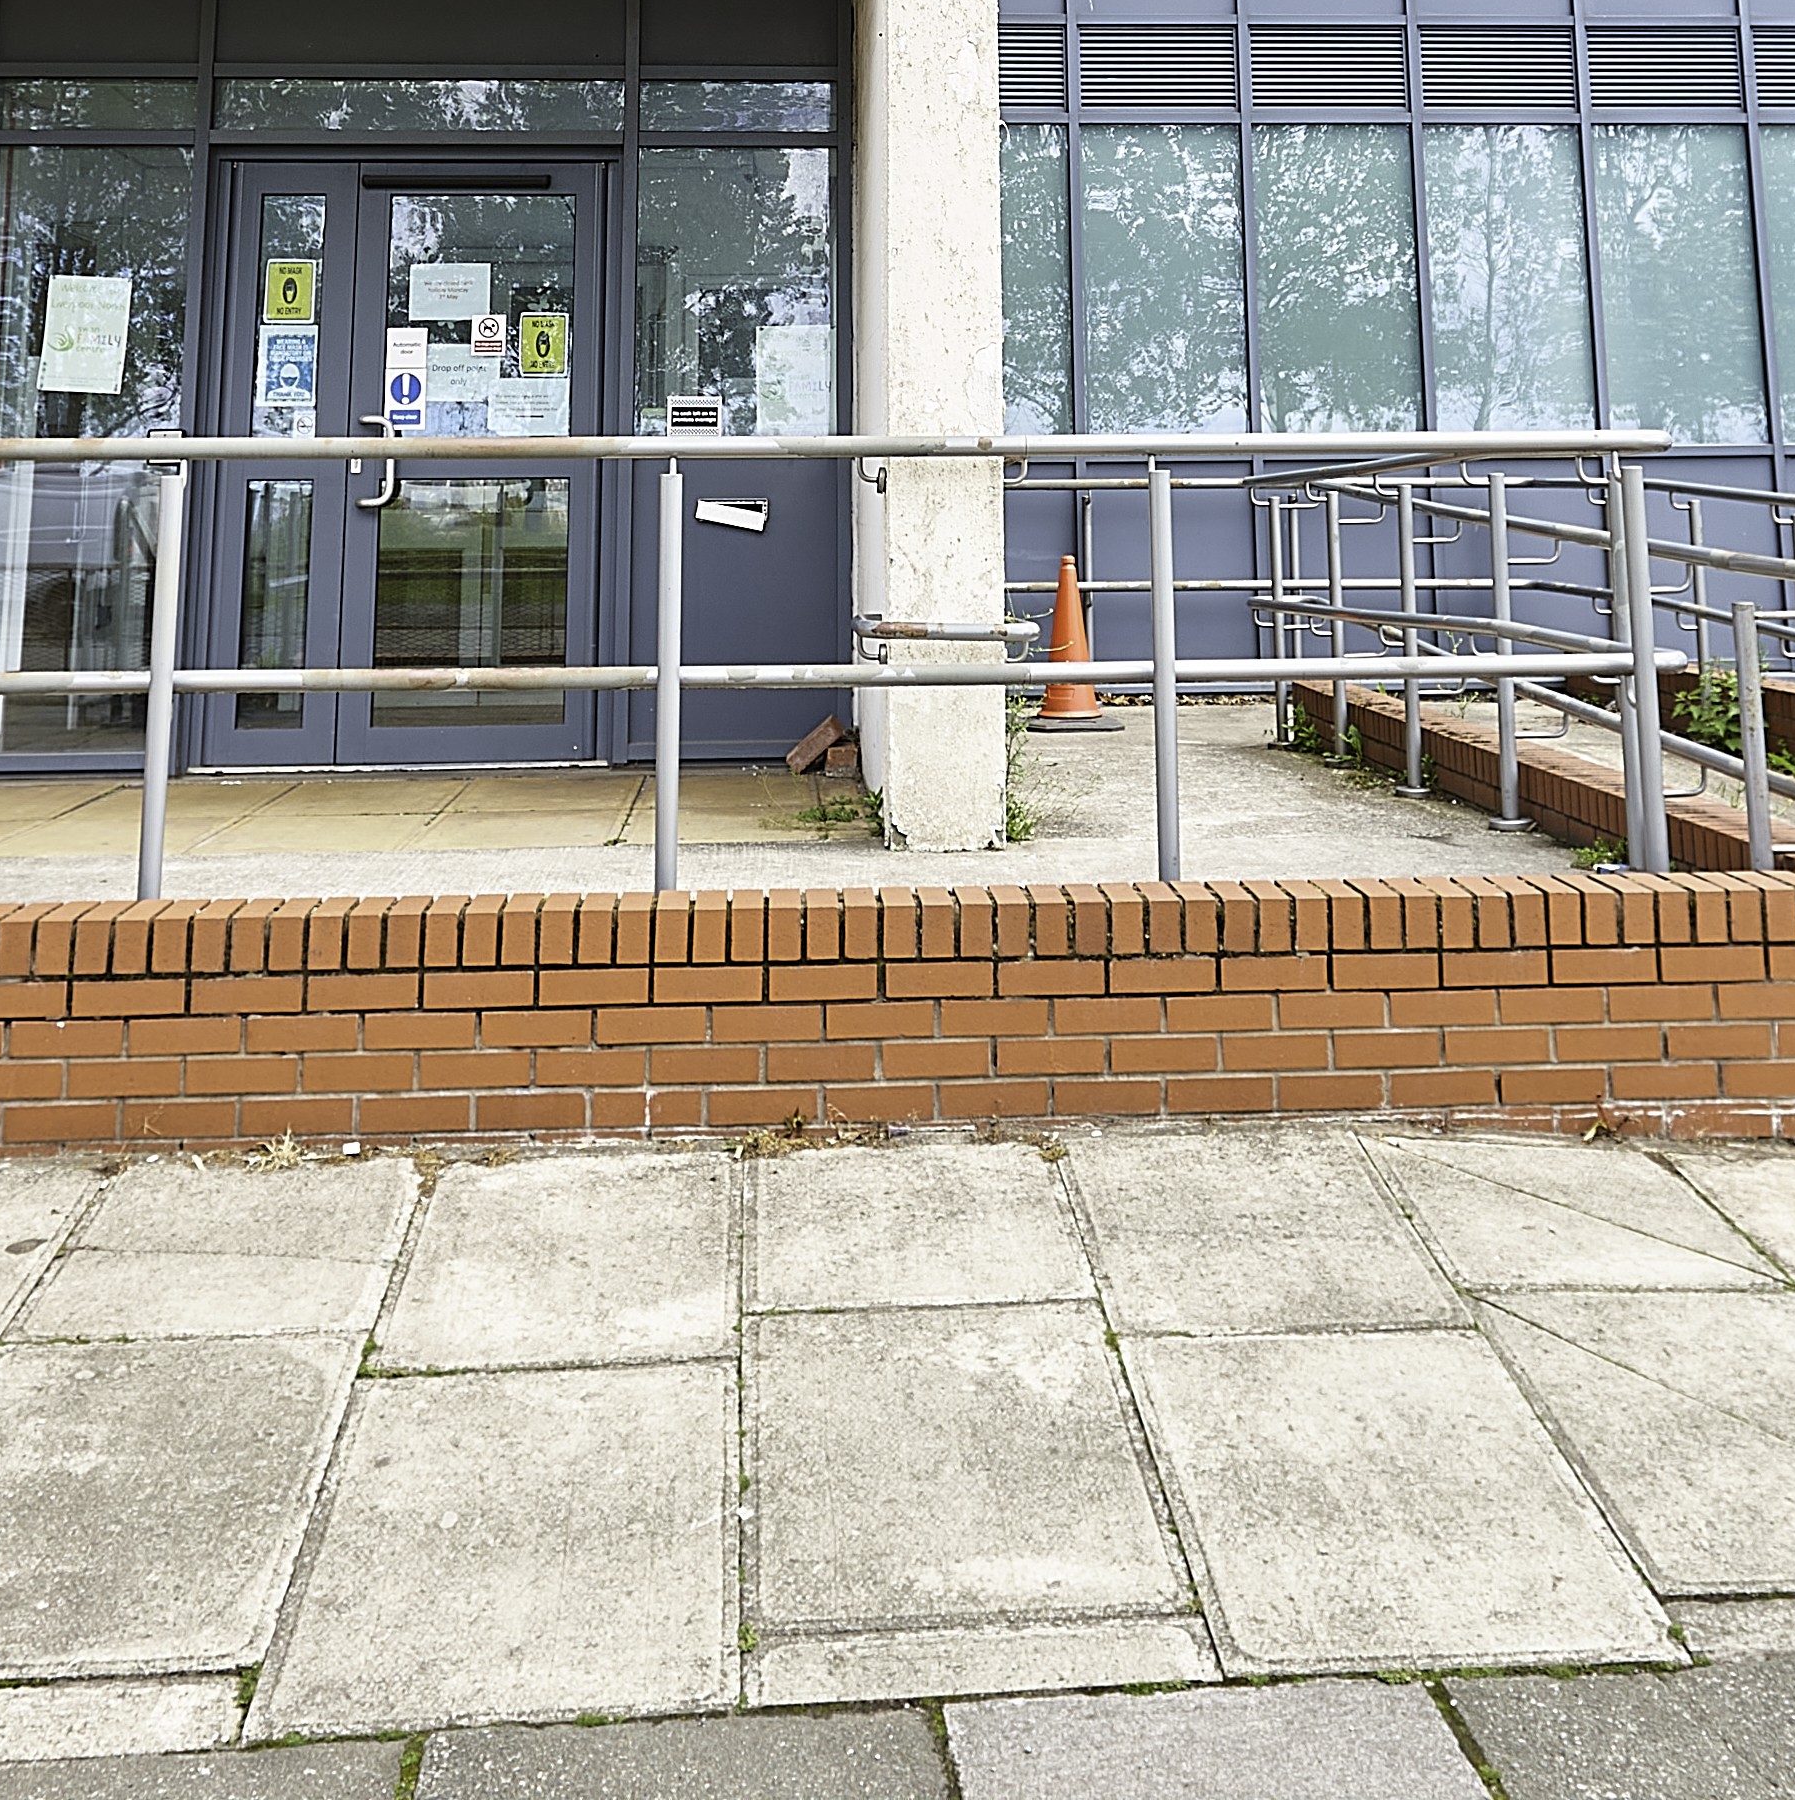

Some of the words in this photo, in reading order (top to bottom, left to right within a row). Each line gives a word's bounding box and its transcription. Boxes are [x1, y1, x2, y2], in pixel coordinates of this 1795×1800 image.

[287, 266, 303, 275] MASK
[285, 307, 302, 315] ENTRY
[432, 364, 452, 374] Drop
[453, 364, 465, 372] off
[450, 378, 468, 387] only
